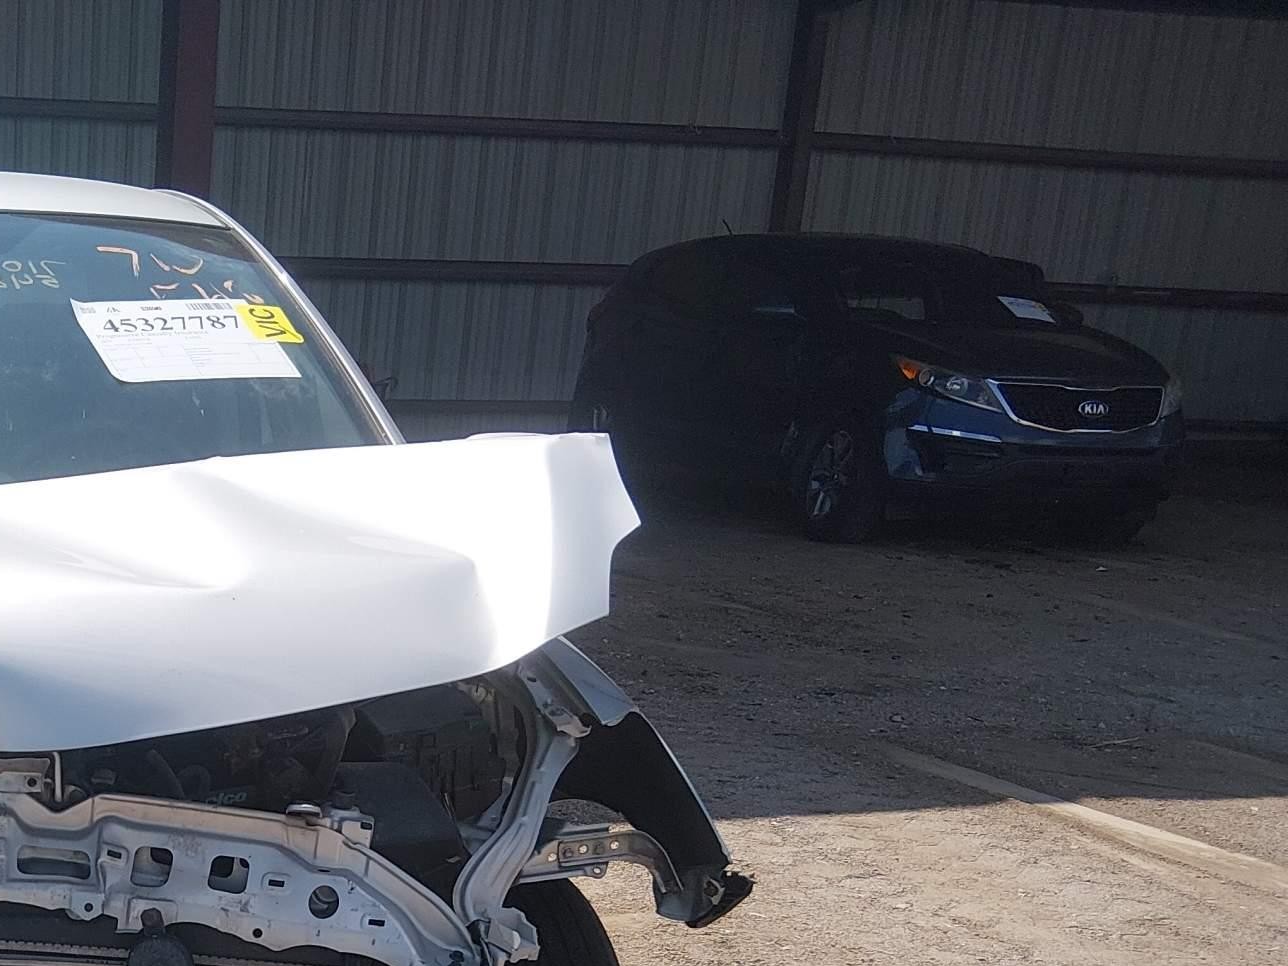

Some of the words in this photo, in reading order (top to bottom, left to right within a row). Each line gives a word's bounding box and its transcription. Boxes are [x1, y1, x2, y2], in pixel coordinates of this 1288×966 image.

[103, 315, 239, 333] 45327787
[248, 307, 287, 338] VIC
[1084, 403, 1105, 415] KIA
